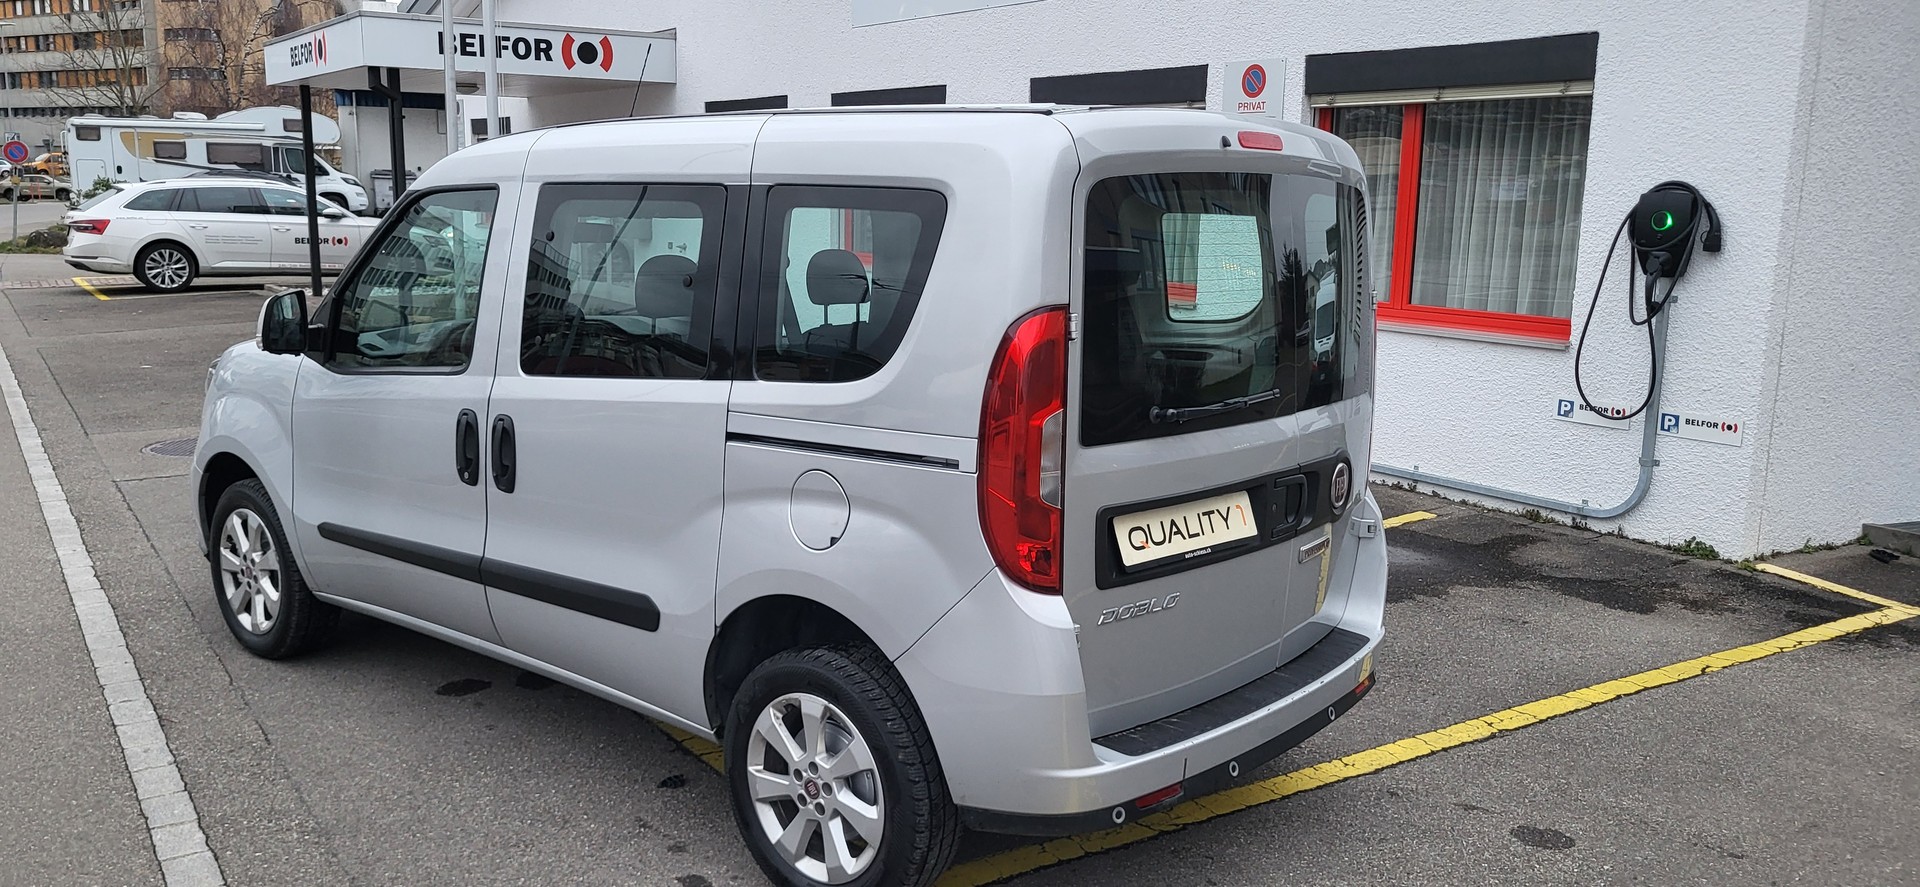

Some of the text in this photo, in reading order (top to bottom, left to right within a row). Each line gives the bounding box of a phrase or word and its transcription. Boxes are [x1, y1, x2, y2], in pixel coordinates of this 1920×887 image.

[290, 41, 313, 67] BELFOR
[1237, 101, 1266, 111] PRIVAT
[1560, 401, 1571, 415] P
[1664, 415, 1719, 430] P BELFOR
[1128, 504, 1247, 551] QUALITY 1
